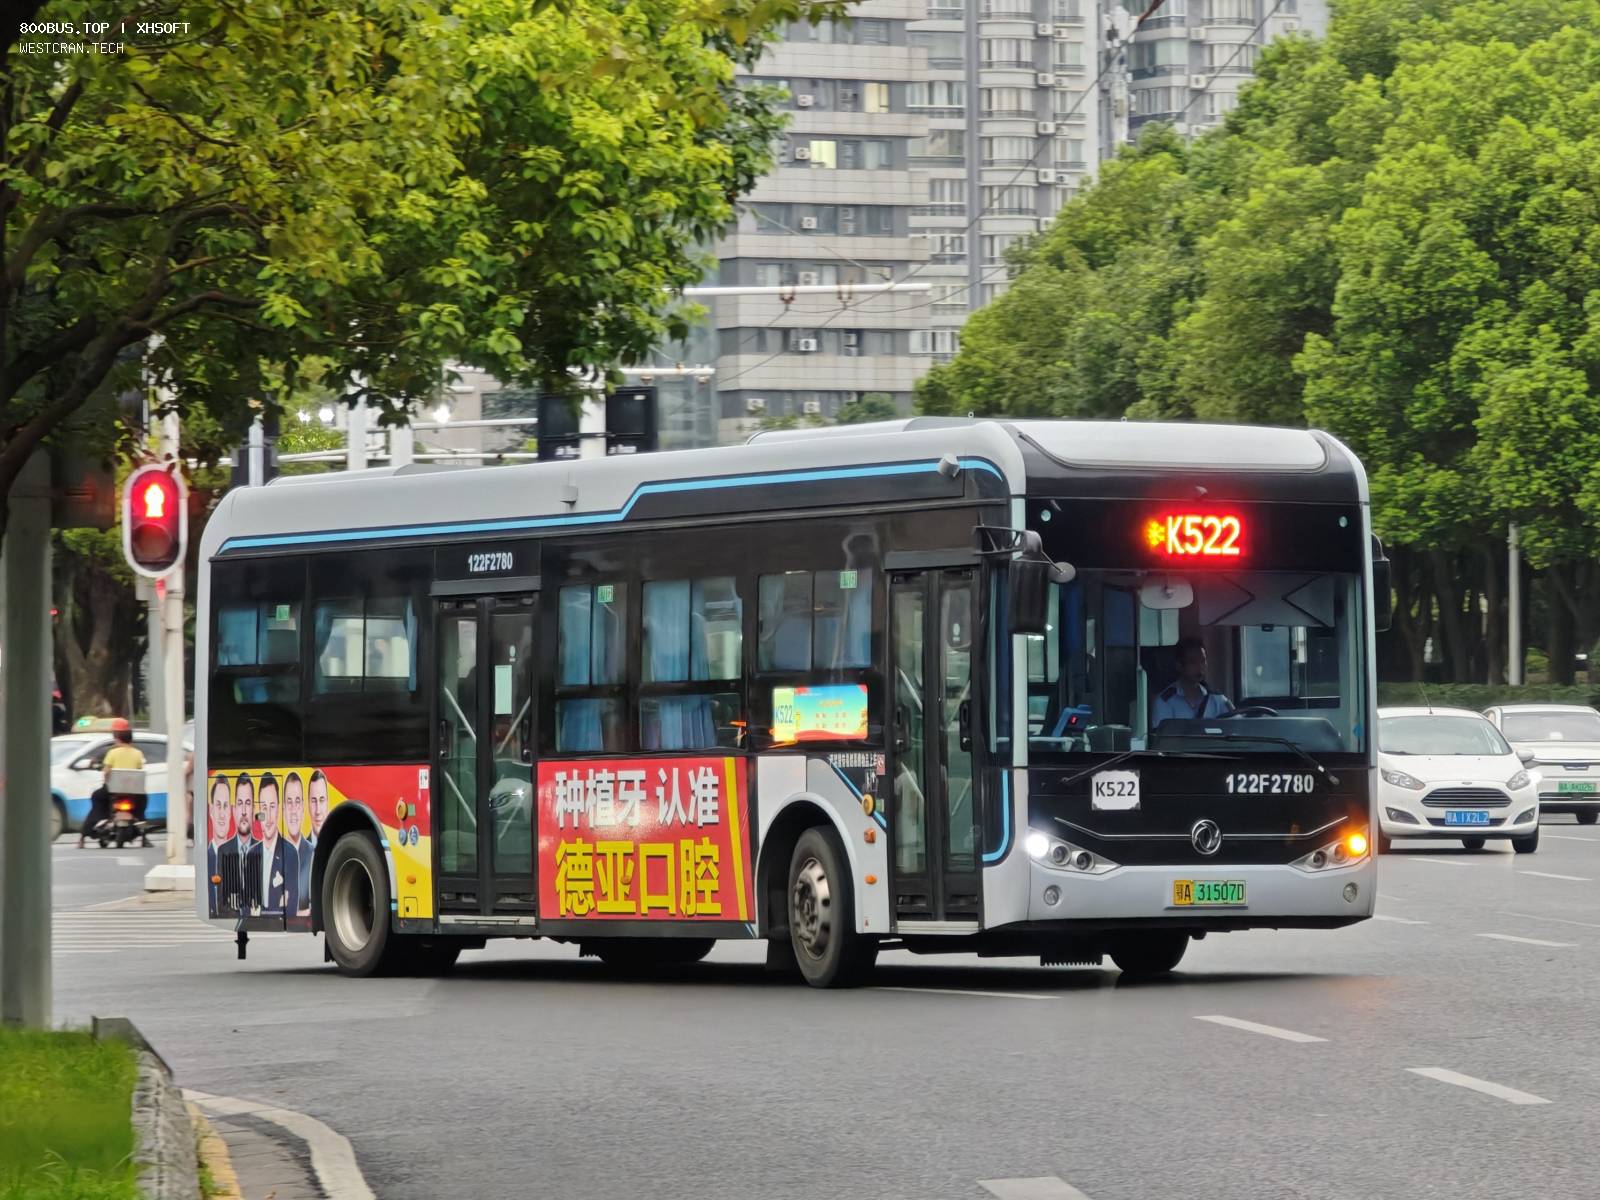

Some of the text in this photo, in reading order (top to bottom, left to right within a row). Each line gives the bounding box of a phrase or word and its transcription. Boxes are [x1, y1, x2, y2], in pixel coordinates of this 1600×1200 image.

[1167, 515, 1240, 554] K522
[467, 551, 513, 572] 122F2780
[775, 705, 793, 724] K522
[1095, 781, 1137, 797] K522
[1225, 774, 1314, 793] 122F2780
[555, 766, 719, 829] 种植牙 认准
[555, 837, 721, 916] 德亚口腔
